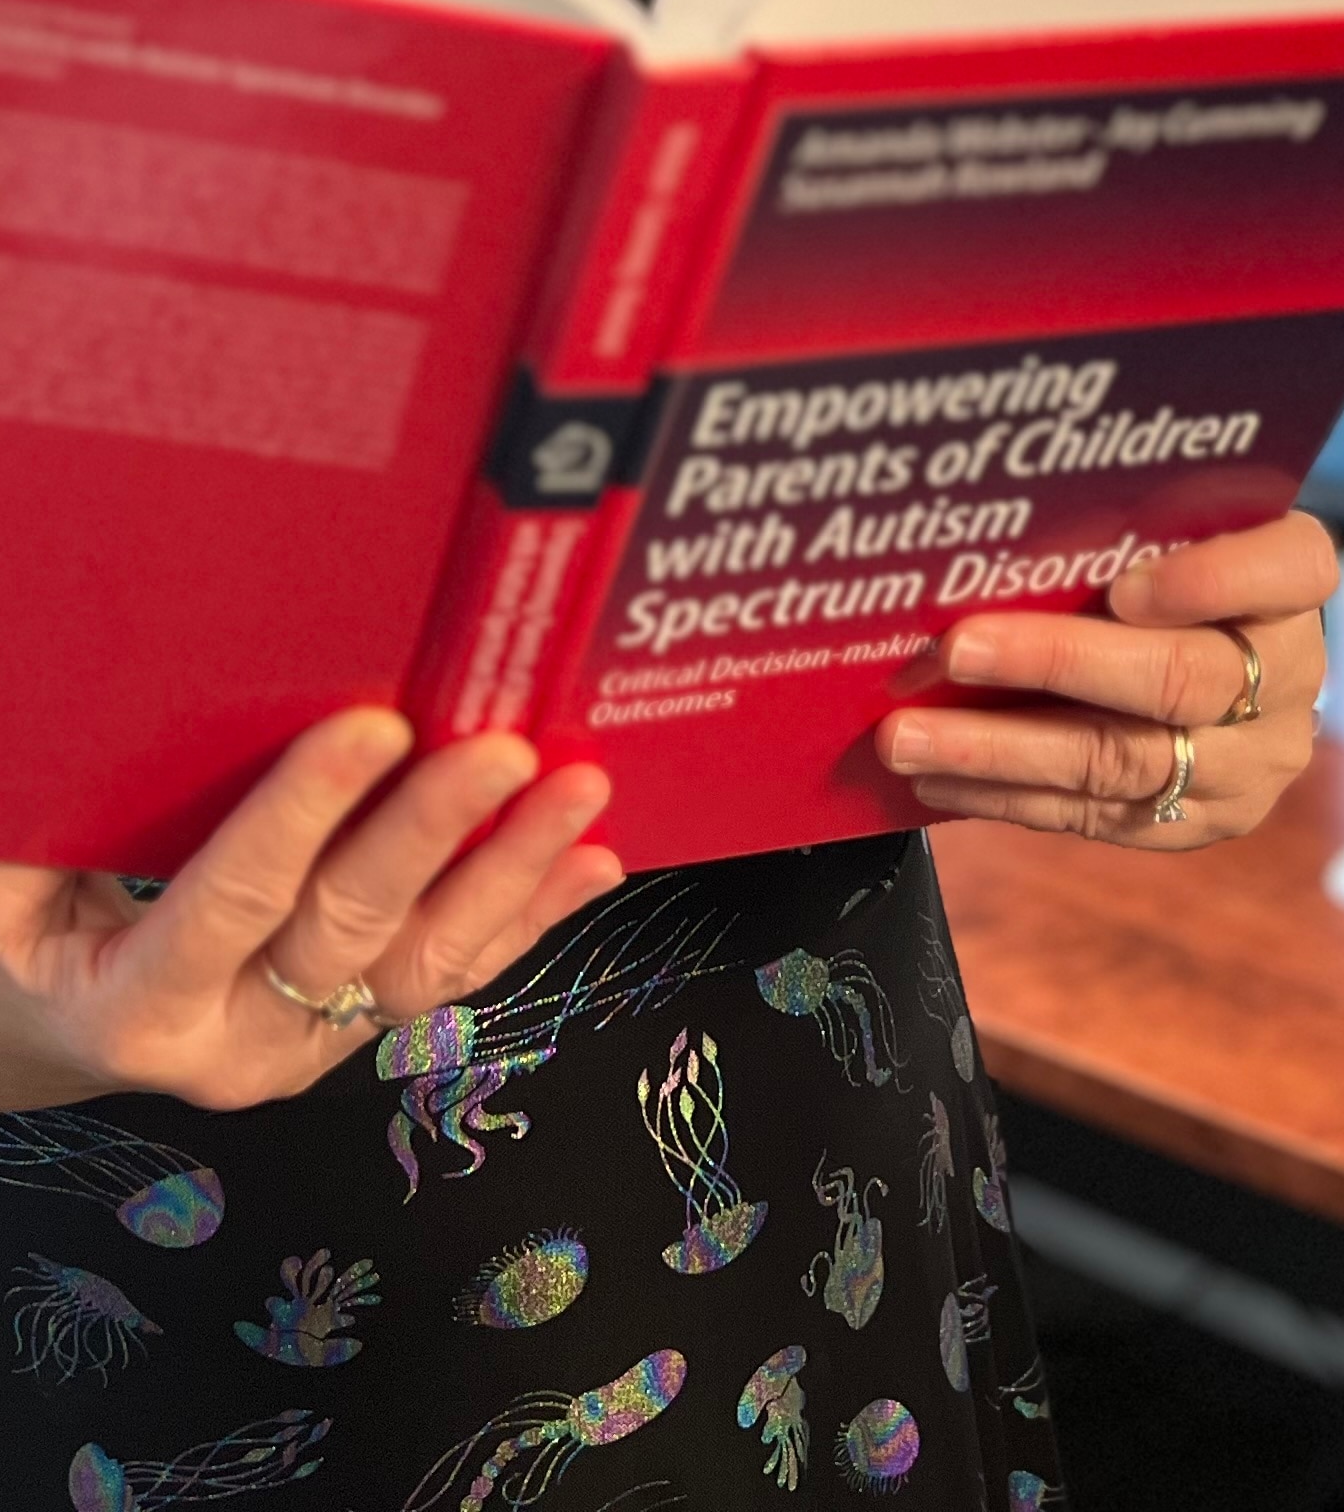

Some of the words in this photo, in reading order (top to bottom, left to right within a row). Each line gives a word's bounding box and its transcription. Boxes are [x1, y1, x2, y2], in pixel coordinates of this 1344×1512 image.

[691, 355, 1116, 449] Empowering
[666, 438, 916, 518] Parents
[926, 422, 1014, 484] of
[1004, 407, 1261, 479] Children
[645, 512, 795, 582] with
[807, 496, 1032, 564] Autism
[617, 570, 924, 655] Spectrum
[935, 532, 1191, 607] Disorde
[588, 687, 737, 728] Outcomes
[598, 659, 705, 698] Critical
